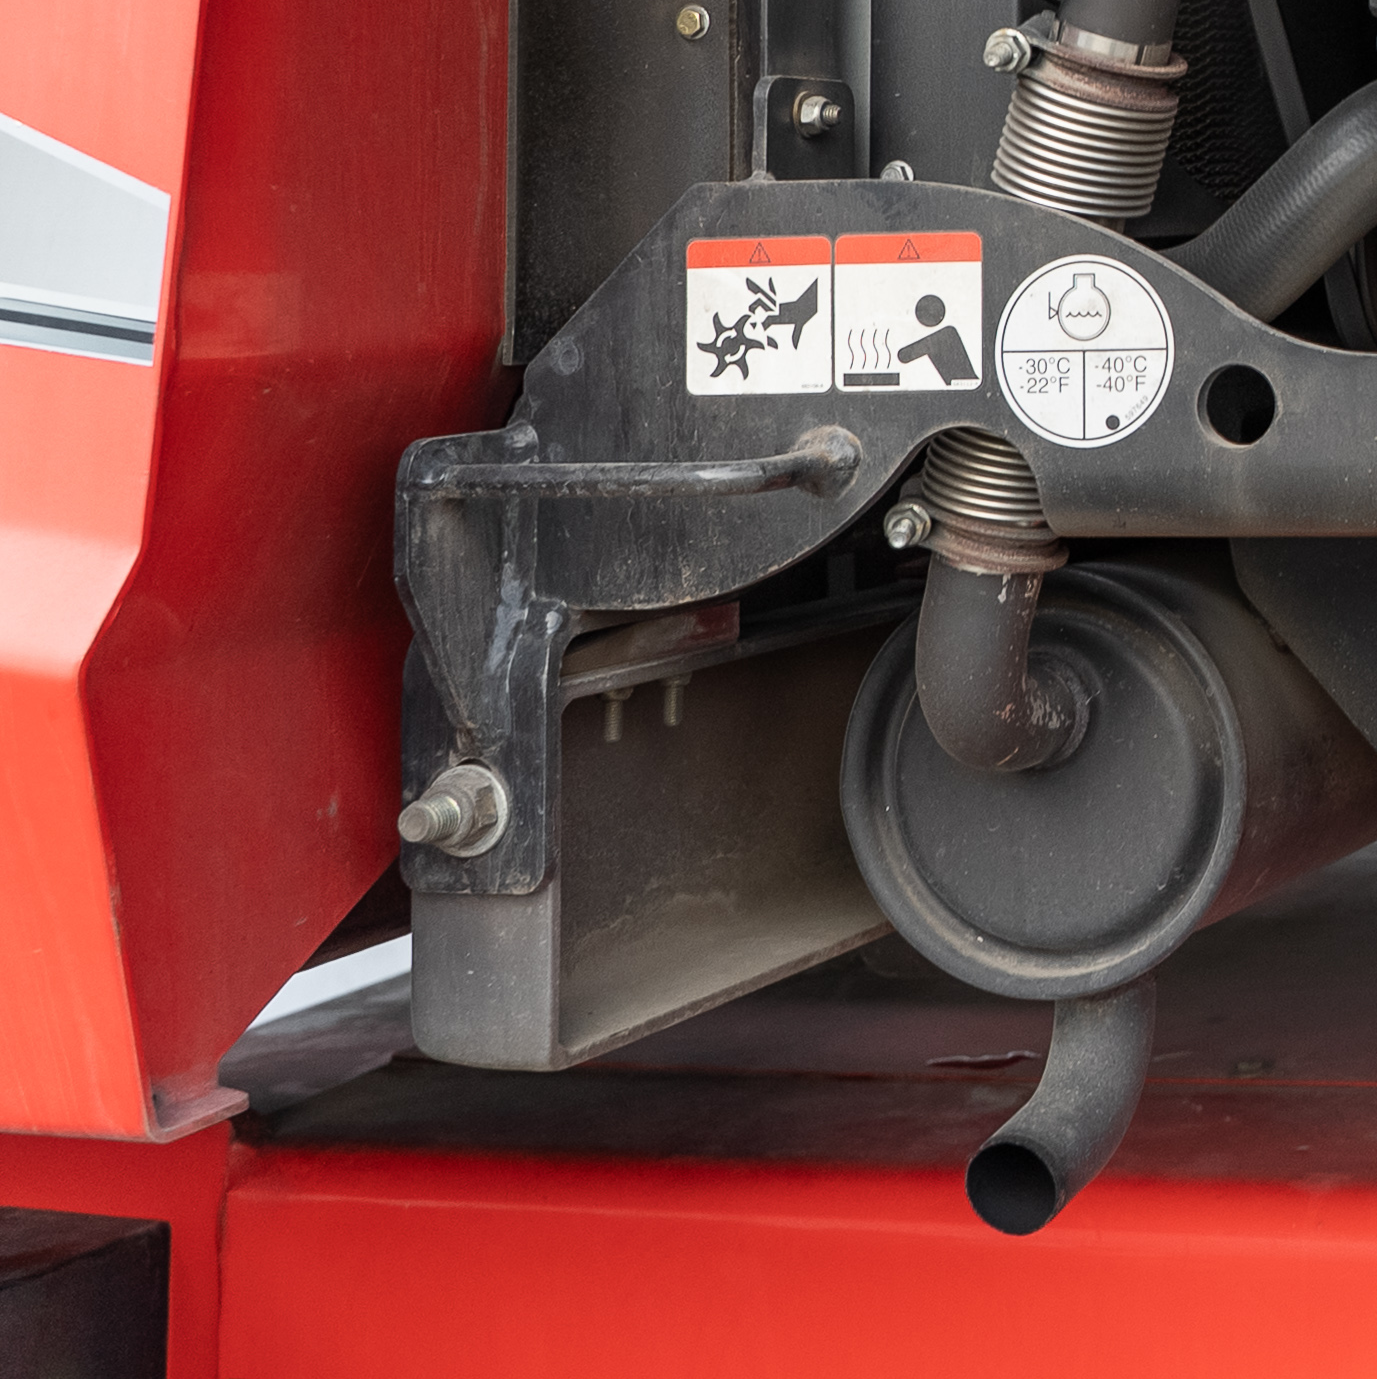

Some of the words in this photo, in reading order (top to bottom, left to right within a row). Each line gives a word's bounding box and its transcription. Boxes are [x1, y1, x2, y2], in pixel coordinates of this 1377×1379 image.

[1018, 356, 1071, 375] -30°C
[1094, 355, 1148, 374] -40°C
[1019, 376, 1070, 394] -22°F
[1096, 374, 1147, 393] -40°F
